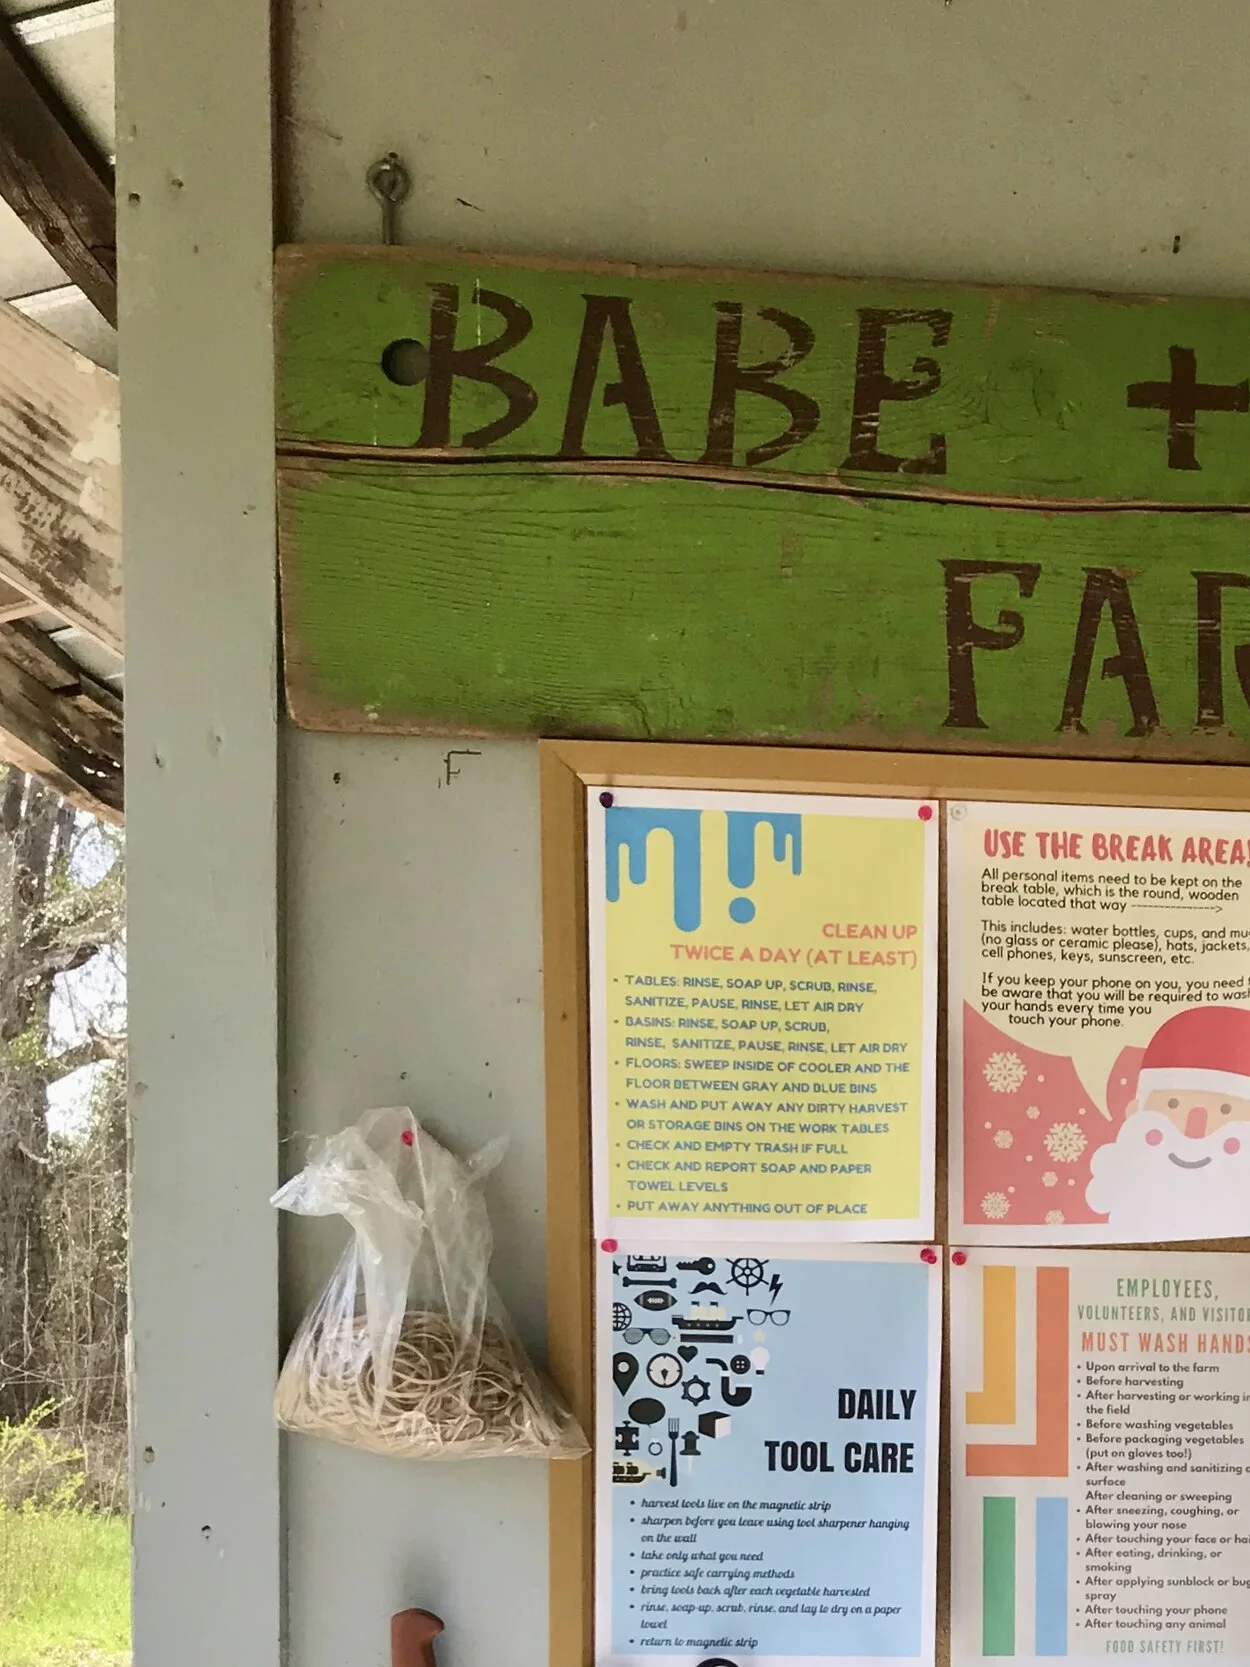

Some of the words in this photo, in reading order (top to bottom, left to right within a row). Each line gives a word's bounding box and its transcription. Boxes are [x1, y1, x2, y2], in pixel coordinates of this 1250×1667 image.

[411, 281, 954, 475] BABE
[983, 829, 1026, 859] USE
[1034, 831, 1083, 861] THE
[1091, 833, 1174, 864] BREAK
[980, 867, 999, 881] All
[1001, 868, 1058, 885] personal
[1060, 870, 1095, 884] items
[1097, 871, 1130, 885] need
[1133, 872, 1147, 885] to
[1149, 873, 1167, 886] be
[1169, 873, 1199, 890] kept
[1201, 878, 1218, 887] on
[1220, 875, 1243, 888] the
[980, 881, 1019, 894] break
[1022, 882, 1059, 898] table,
[1063, 883, 1102, 897] which
[1104, 884, 1115, 897] is
[1117, 885, 1140, 898] the
[1142, 885, 1184, 902] round,
[1187, 887, 1239, 901] wooden
[821, 923, 888, 940] CLEAN
[891, 924, 917, 941] UP
[982, 920, 1007, 933] This
[1009, 921, 1066, 934] includes:
[1070, 922, 1109, 935] water
[1111, 923, 1159, 939] bottles,
[1163, 928, 1197, 940] cups,
[1200, 925, 1226, 938] and
[669, 944, 734, 962] TWICE
[738, 946, 754, 963] A
[758, 947, 802, 964] DAY
[805, 948, 843, 966] (AT
[846, 949, 917, 968] LEAST)
[980, 946, 1004, 959] cell
[1006, 947, 1056, 964] phones,
[1060, 948, 1094, 965] keys,
[1097, 953, 1166, 967] sunscreen,
[1170, 951, 1194, 965] etc.
[623, 975, 680, 988] TABLES:
[682, 976, 724, 991] RINSE,
[725, 977, 763, 990] SOAP
[764, 978, 787, 992] UP,
[788, 979, 835, 993] SCRUB,
[836, 980, 877, 994] RINSE,
[624, 995, 689, 1010] SANITIZE,
[690, 997, 739, 1011] PAUSE,
[740, 998, 782, 1013] RINSE,
[783, 999, 811, 1012] LET
[812, 1000, 835, 1013] AIR
[836, 1001, 864, 1013] DRY
[980, 1002, 1011, 1015] your
[1013, 999, 1054, 1013] hands
[1056, 1004, 1094, 1016] every
[1097, 1001, 1125, 1014] time
[1127, 1005, 1152, 1017] you
[1007, 1011, 1045, 1025] touch
[1047, 1016, 1078, 1029] your
[1080, 1013, 1124, 1030] phone.
[625, 1057, 681, 1070] FLOORS:
[683, 1058, 730, 1071] SWEEP
[731, 1059, 775, 1071] INSIDE
[776, 1059, 797, 1072] OF
[797, 1060, 852, 1073] COOLER
[853, 1061, 882, 1073] AND
[884, 1061, 910, 1074] THE
[626, 1138, 670, 1151] CHECK
[673, 1139, 702, 1152] AND
[704, 1140, 752, 1153] EMPTY
[753, 1141, 799, 1154] TRASH
[800, 1142, 814, 1154] IF
[815, 1142, 849, 1155] FULL
[627, 1179, 676, 1192] TOWEL
[677, 1180, 729, 1193] LEVELS
[1116, 1278, 1219, 1301] EMPLOYEES,
[1076, 1305, 1164, 1323] VOLUNTEERS,
[1169, 1306, 1196, 1322] AND
[1080, 1331, 1130, 1353] MUST
[1137, 1332, 1188, 1354] WASH
[1085, 1362, 1116, 1375] Upon
[1117, 1362, 1156, 1373] arrival
[1157, 1362, 1170, 1373] to
[1171, 1363, 1190, 1373] the
[1192, 1363, 1220, 1373] farm
[1085, 1376, 1123, 1387] Before
[1124, 1377, 1184, 1391] harvesting
[837, 1388, 917, 1421] DAILY
[1084, 1391, 1114, 1402] After
[1116, 1391, 1176, 1404] harvesting
[1177, 1394, 1191, 1402] or
[1192, 1392, 1240, 1405] working
[1085, 1404, 1104, 1415] the
[1105, 1405, 1130, 1415] field
[1085, 1419, 1122, 1430] Before
[1123, 1420, 1172, 1433] washing
[1173, 1420, 1234, 1433] vegetables
[1085, 1434, 1122, 1445] Before
[1123, 1434, 1183, 1448] packaging
[1184, 1435, 1245, 1448] vegetables
[763, 1440, 835, 1473] TOOL
[843, 1441, 914, 1474] CARE
[1085, 1448, 1109, 1461] (put
[1110, 1451, 1125, 1459] on
[1127, 1448, 1164, 1461] gloves
[1165, 1449, 1192, 1462] too!)
[640, 1498, 679, 1509] harvest
[680, 1498, 705, 1509] tools
[706, 1499, 726, 1510] live
[726, 1502, 740, 1510] on
[741, 1499, 758, 1510] the
[758, 1499, 806, 1514] magnetic
[807, 1500, 832, 1514] strip
[639, 1567, 681, 1581] practice
[682, 1568, 704, 1579] safe
[705, 1568, 751, 1582] carrying
[751, 1568, 795, 1579] methods
[640, 1584, 669, 1598] bring
[669, 1585, 695, 1595] tools
[695, 1585, 721, 1596] back
[722, 1585, 748, 1596] after
[748, 1585, 773, 1596] each
[774, 1585, 821, 1600] vegetable
[821, 1586, 870, 1597] harvested
[1105, 1639, 1134, 1653] FOOD
[1138, 1639, 1182, 1654] SAFETY
[1186, 1640, 1224, 1654] FIRST!
